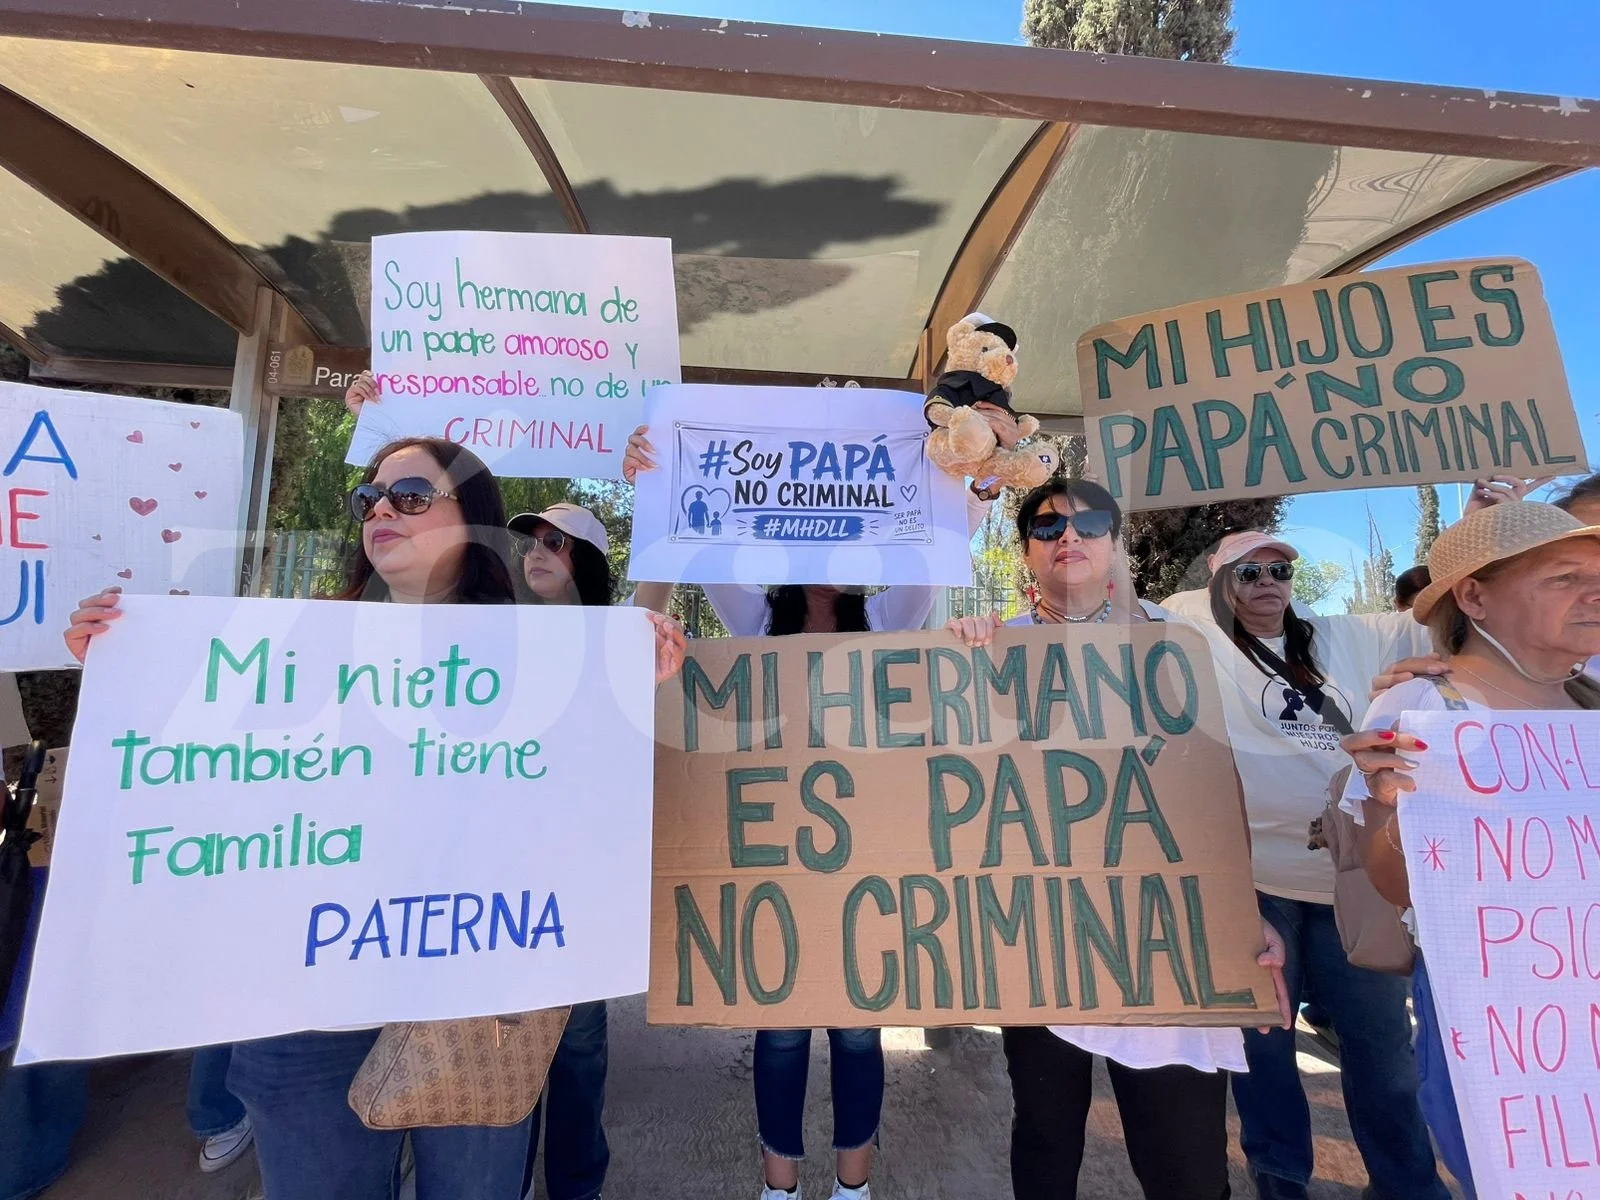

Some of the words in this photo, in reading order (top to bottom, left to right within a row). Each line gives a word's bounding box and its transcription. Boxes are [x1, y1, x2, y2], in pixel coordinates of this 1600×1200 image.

[385, 259, 442, 321] Soy
[456, 257, 587, 316] hermana
[600, 286, 639, 323] de
[381, 329, 412, 352] un
[424, 327, 495, 360] padre
[505, 334, 609, 361] amoroso
[1092, 319, 1188, 399] MI
[1205, 280, 1394, 377] HIJO
[1408, 265, 1525, 353] ES
[268, 350, 281, 384] 04-061
[551, 376, 584, 397] no
[596, 372, 629, 398] de
[1306, 356, 1465, 413] NO
[445, 417, 612, 453] CRIMINAL
[788, 433, 895, 481] PAPÁ
[1099, 372, 1307, 498] PAPÁ
[1311, 399, 1576, 480] CRIMINAL
[734, 480, 768, 508] NO
[777, 482, 894, 508] CRIMINAL
[894, 512, 905, 520] SER
[899, 518, 908, 526] NO
[764, 516, 849, 538] #MHDLL
[205, 637, 296, 705] Mi
[338, 644, 501, 709] nieto
[682, 651, 780, 753] MI
[807, 639, 1199, 749] HERMANO
[409, 727, 547, 780] tiene
[1281, 723, 1316, 732] JUNTOS
[1300, 739, 1335, 751] HIJOS
[726, 760, 855, 873] ES
[927, 734, 1182, 871] PAPÁ
[127, 813, 363, 884] Familia
[1474, 815, 1554, 882] NO
[304, 889, 566, 967] PATERNA
[675, 881, 799, 1006] NO
[842, 873, 1257, 1011] CRIMINAL
[1486, 1003, 1567, 1075] NO
